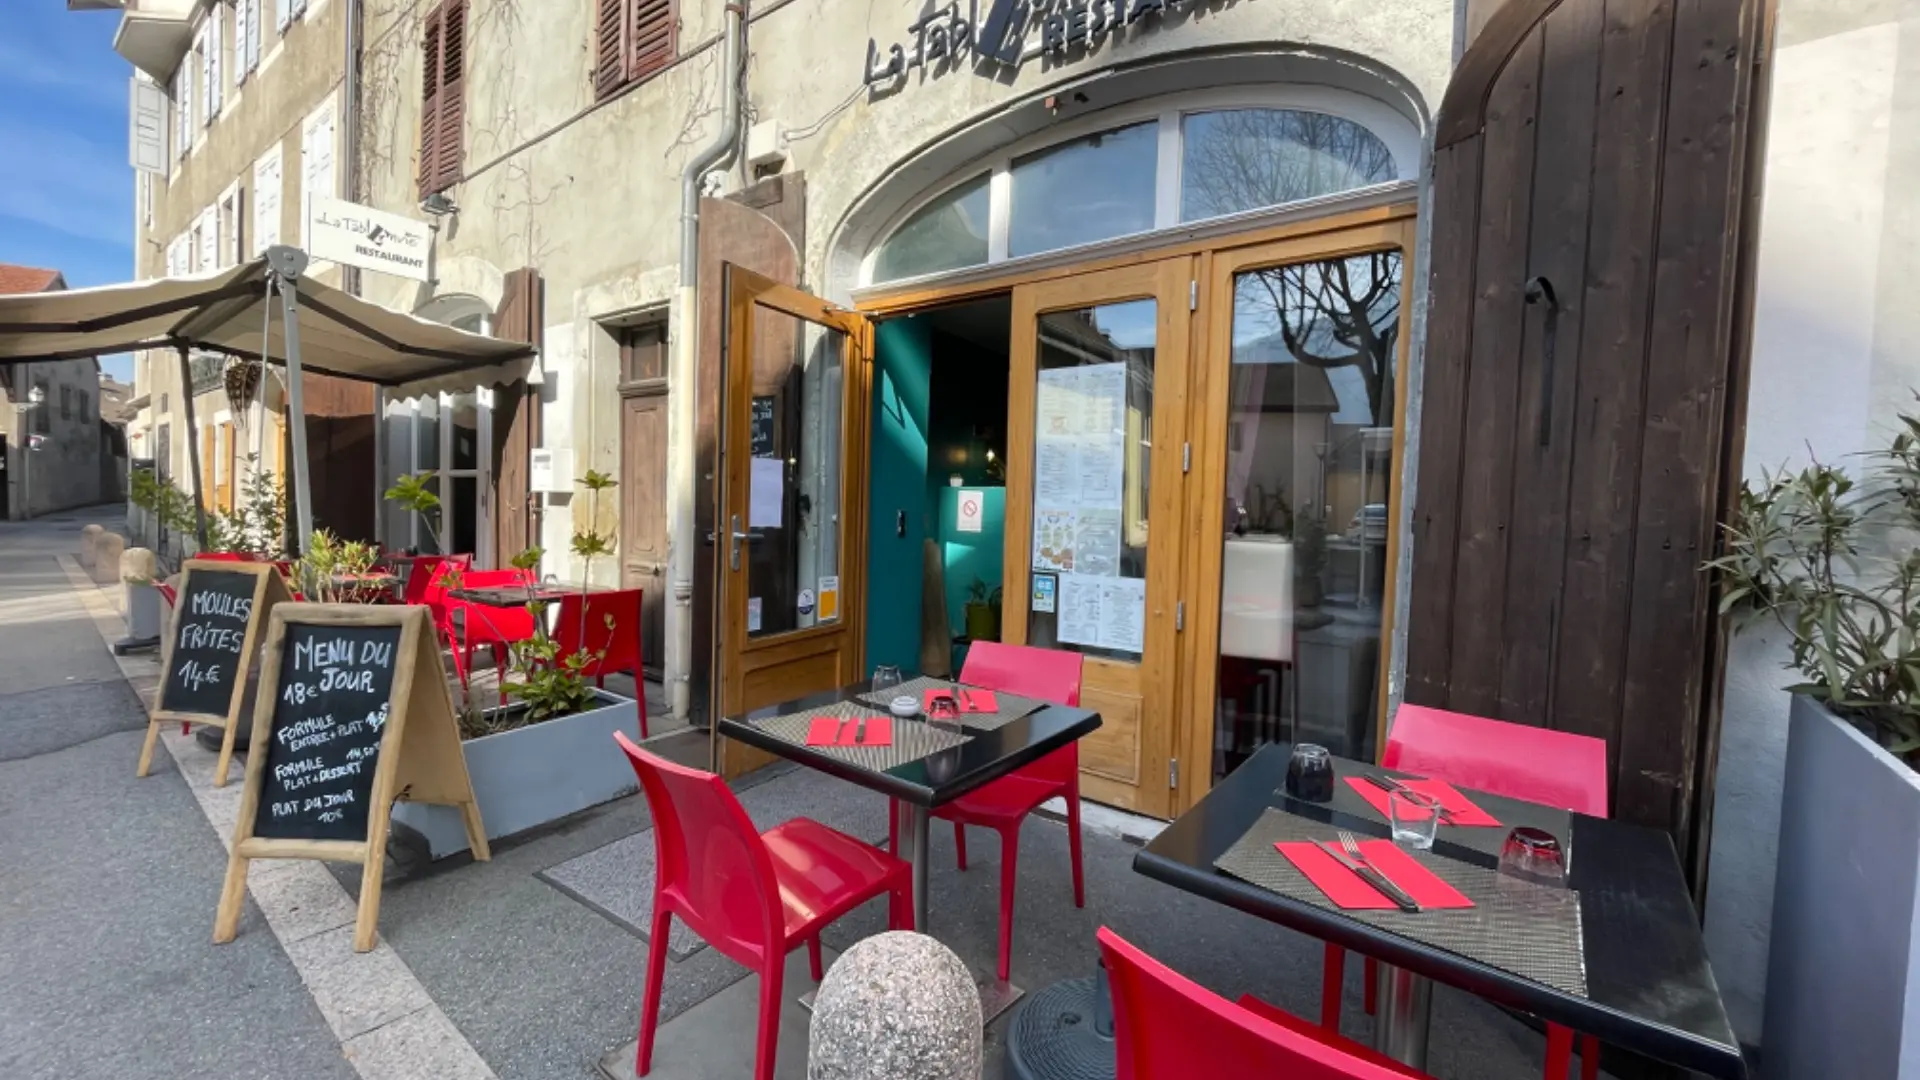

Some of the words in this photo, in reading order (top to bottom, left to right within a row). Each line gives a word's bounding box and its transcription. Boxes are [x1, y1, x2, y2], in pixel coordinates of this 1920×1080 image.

[355, 244, 424, 269] RESTAURANT
[192, 591, 253, 622] MOULES
[294, 635, 355, 672] MENU
[360, 640, 391, 668] DU
[178, 660, 220, 691] 14€
[319, 667, 375, 693] JOUR
[283, 682, 318, 705] 18€
[277, 714, 336, 745] FORMULE
[337, 720, 364, 737] PLAT
[275, 757, 324, 781] FORMULE
[283, 776, 310, 791] PLAT
[319, 761, 363, 782] DESSERT
[272, 800, 299, 817] PLAT
[304, 796, 322, 811] DU
[324, 789, 355, 807] JOUR
[318, 808, 343, 823] 10€
